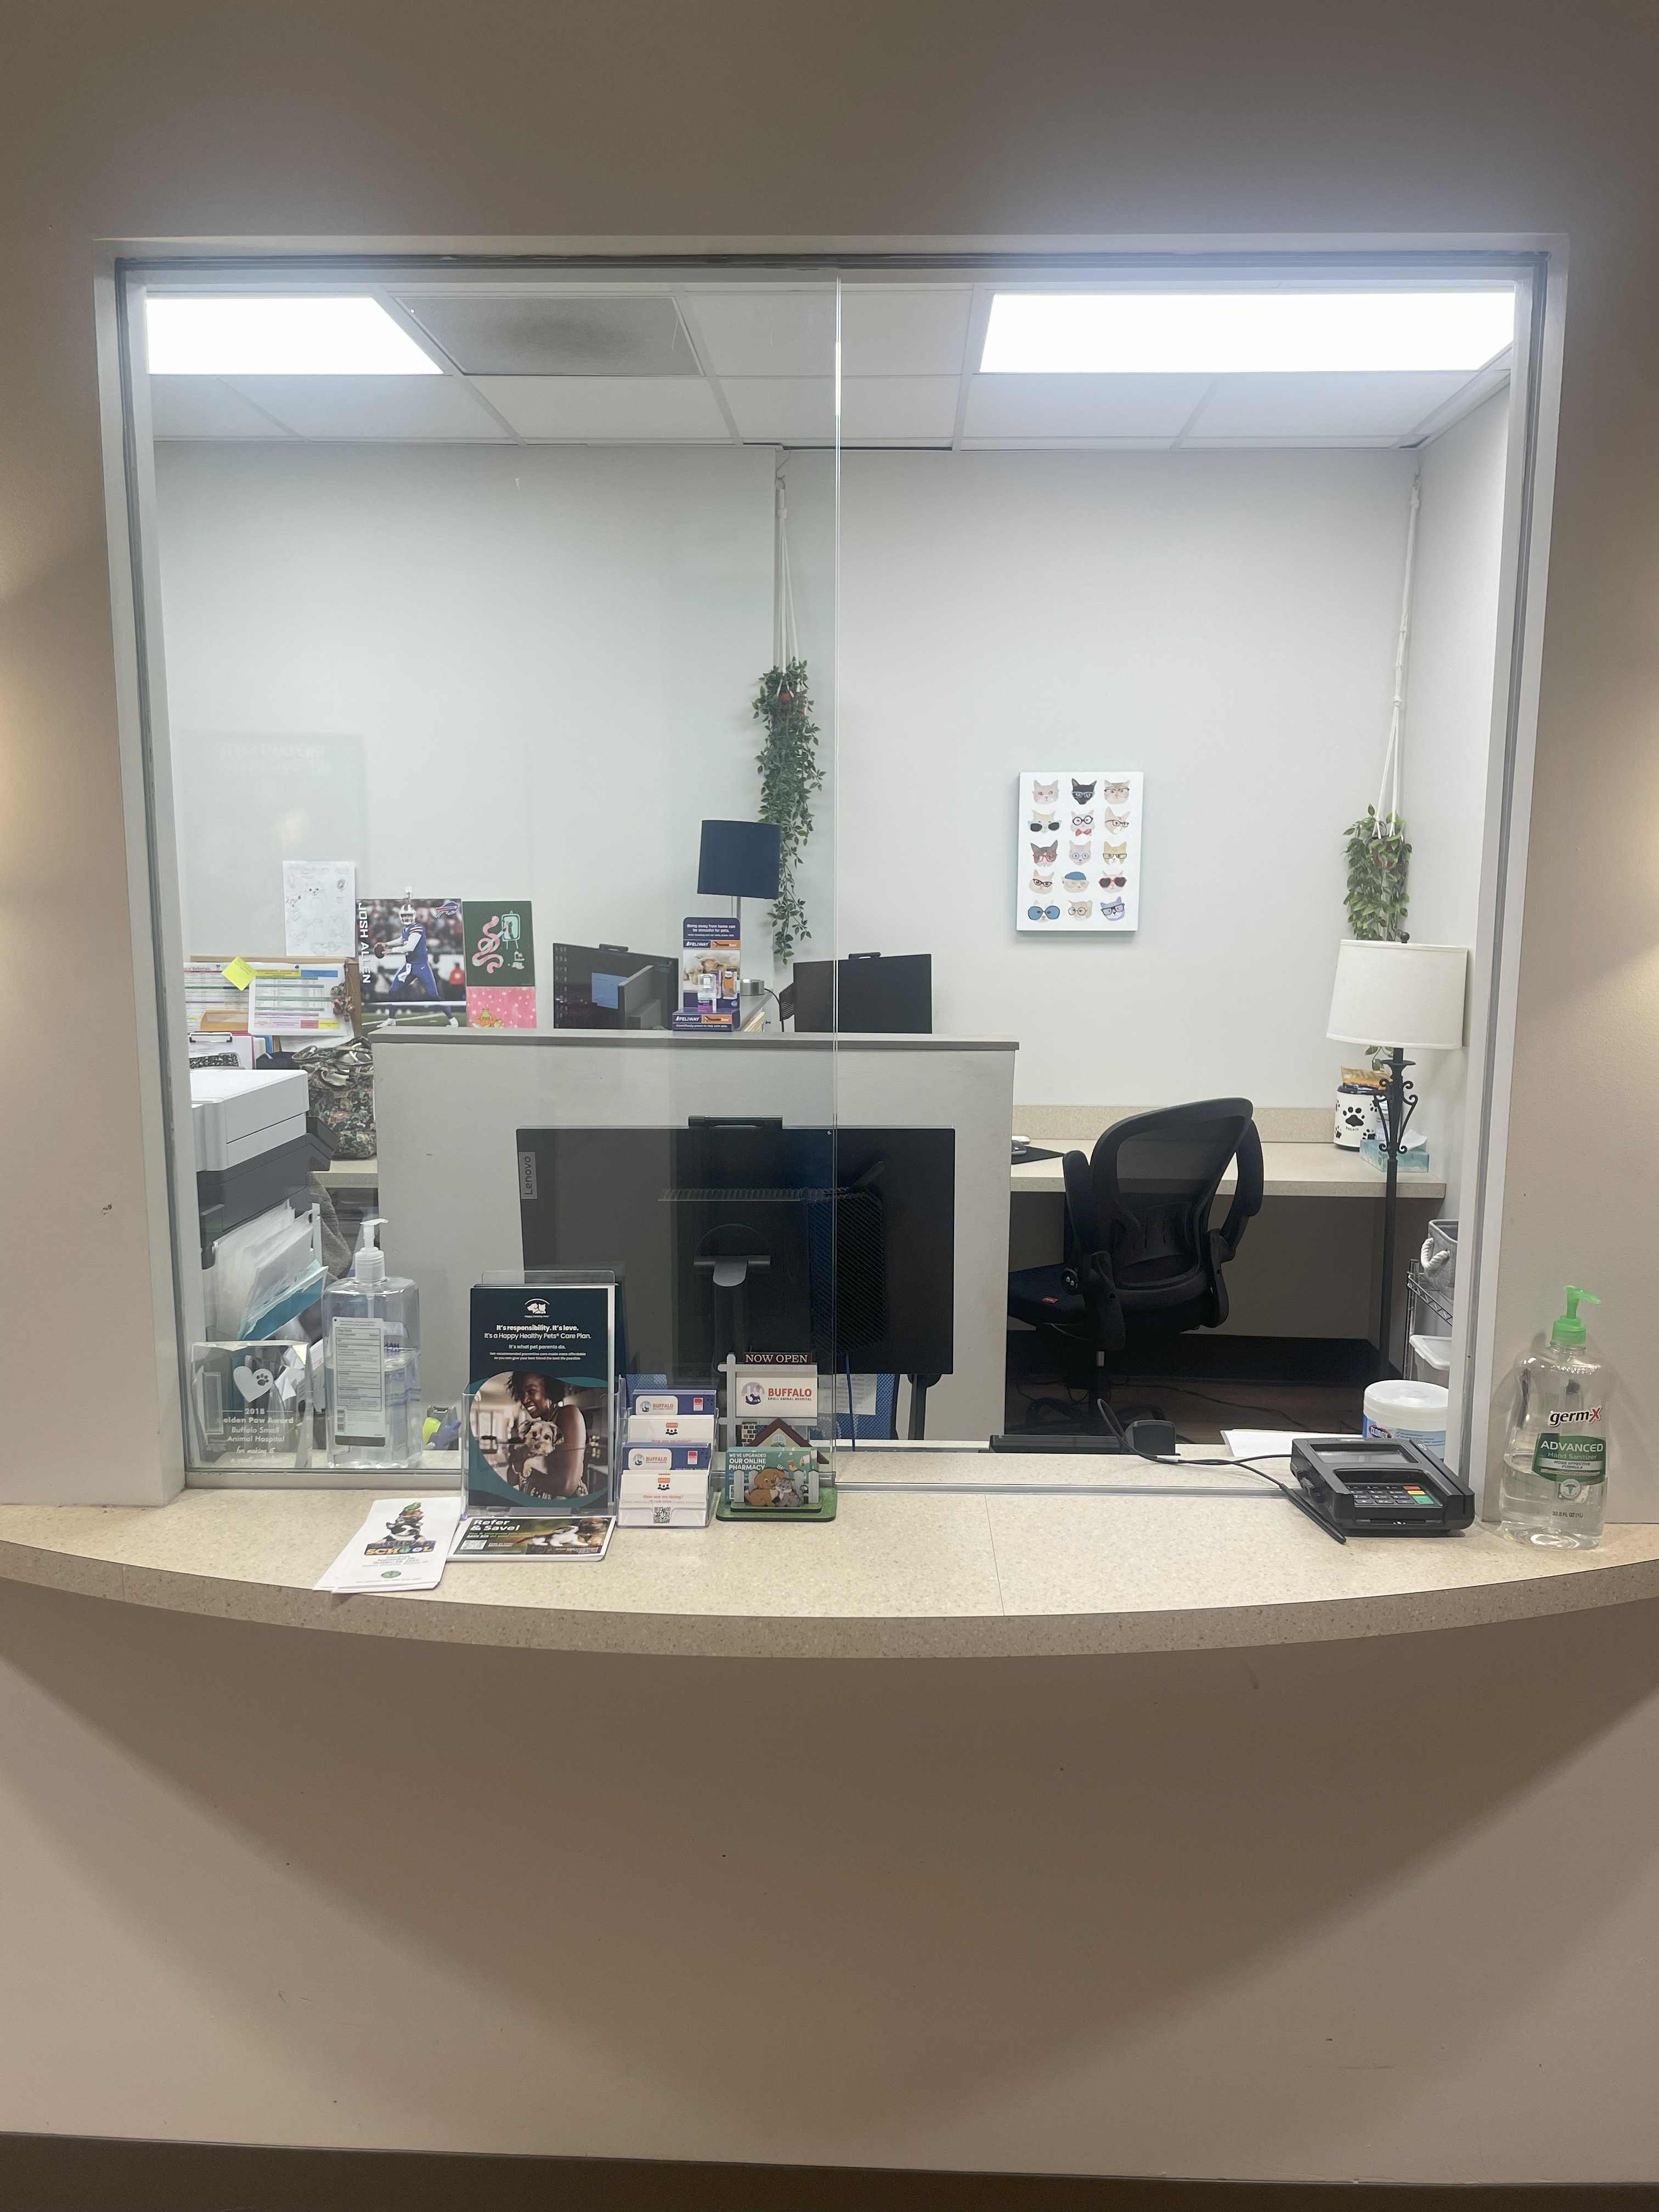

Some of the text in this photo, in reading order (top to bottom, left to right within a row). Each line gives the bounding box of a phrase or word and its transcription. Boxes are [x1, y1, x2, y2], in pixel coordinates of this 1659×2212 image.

[358, 902, 371, 984] JOSH ALLEN
[524, 1156, 533, 1195] Lenovo
[745, 1354, 808, 1363] NOW OPEN
[768, 1388, 812, 1397] BUFFALO
[1549, 1407, 1600, 1426] germ-X
[1370, 1427, 1389, 1438] CLOROX
[255, 1435, 285, 1443] Hospital
[247, 1447, 268, 1456] making
[1541, 1441, 1604, 1452] ADVANCED
